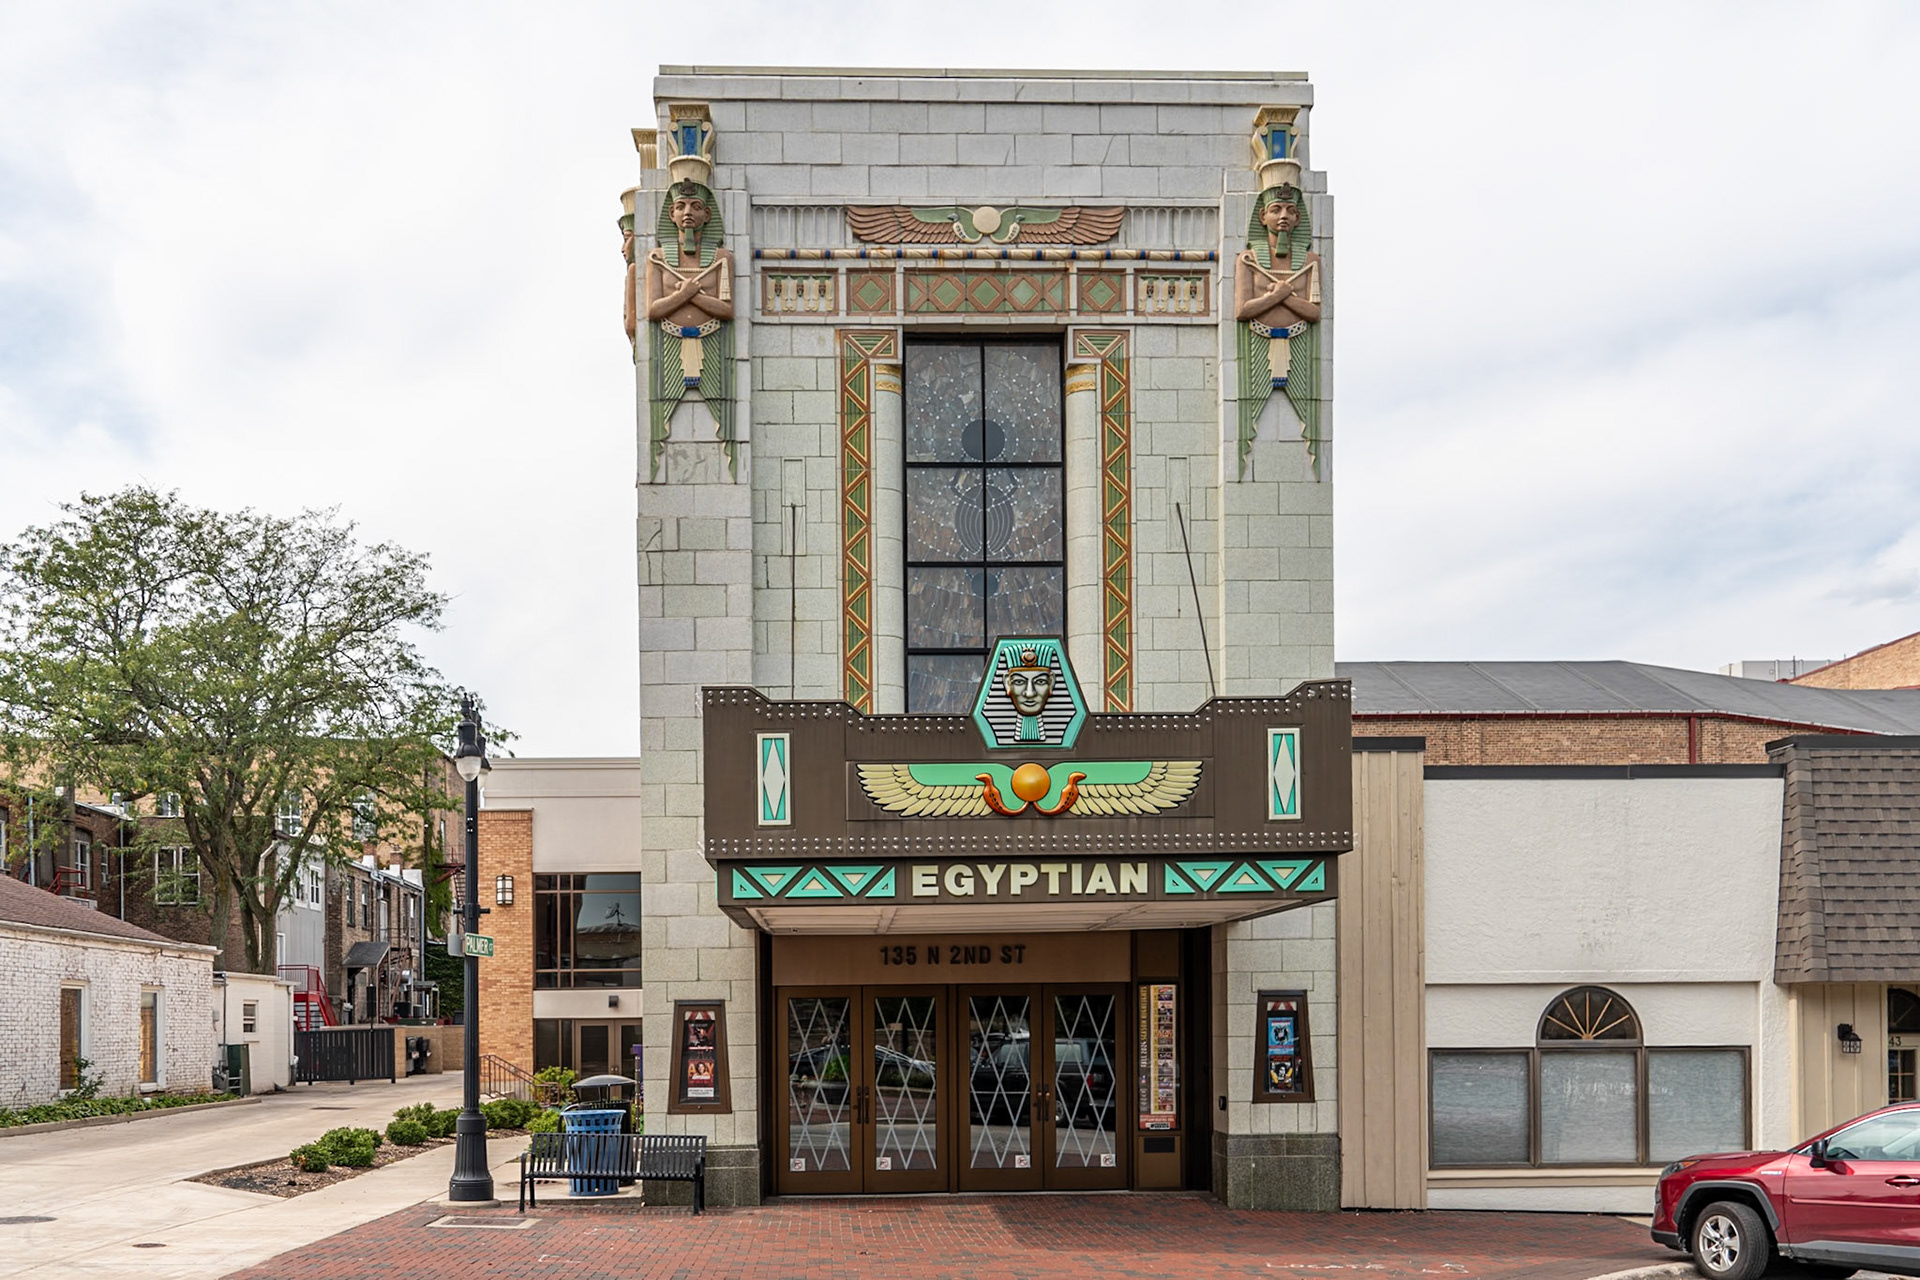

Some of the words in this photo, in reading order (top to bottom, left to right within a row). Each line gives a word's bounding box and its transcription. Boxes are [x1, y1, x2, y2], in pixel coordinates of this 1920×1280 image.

[912, 863, 1148, 896] EGYPTIAN
[466, 936, 489, 955] PALMER
[880, 945, 917, 965] 135
[927, 945, 940, 965] N
[949, 944, 991, 965] 2ND
[1000, 943, 1026, 964] ST
